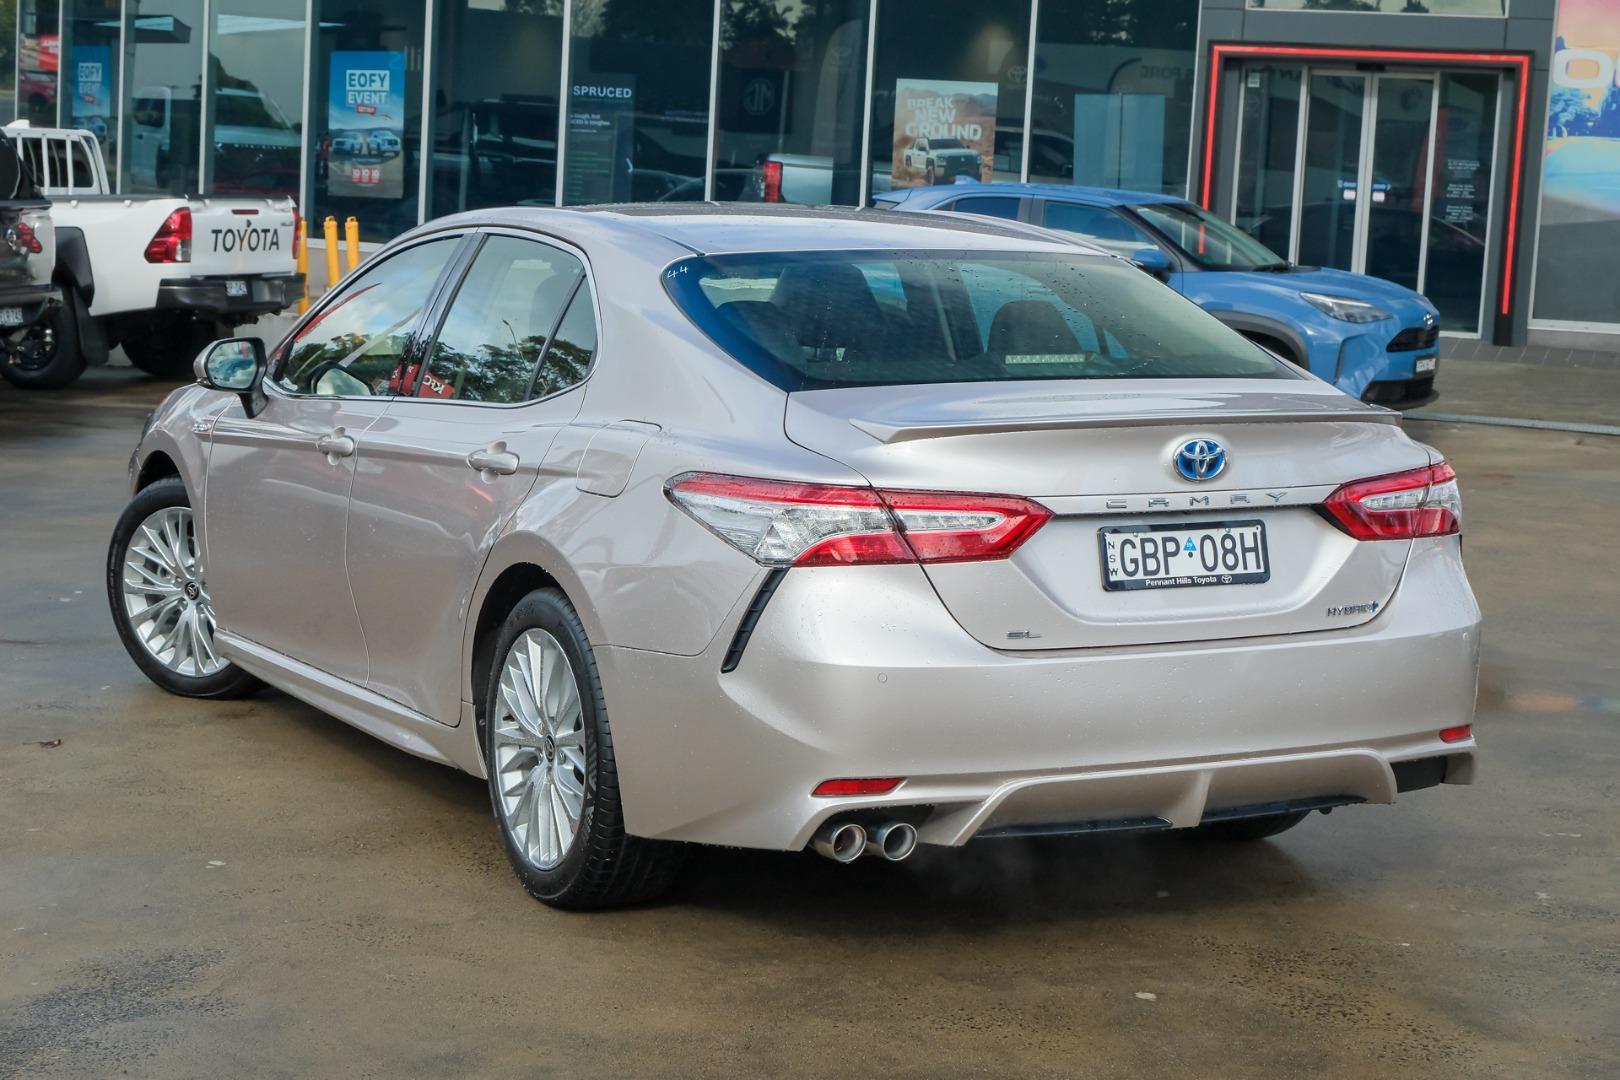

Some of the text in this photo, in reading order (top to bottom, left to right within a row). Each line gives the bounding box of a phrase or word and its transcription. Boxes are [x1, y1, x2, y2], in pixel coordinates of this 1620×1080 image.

[347, 72, 388, 88] EOFY
[347, 91, 388, 104] EVENT
[573, 85, 632, 98] SPRUCED
[906, 96, 954, 110] BREAK
[915, 108, 957, 124] NEW
[905, 120, 982, 141] GROUND
[211, 228, 280, 252] TOYOTA
[1145, 576, 1217, 587] Pennant Hills Toyota
